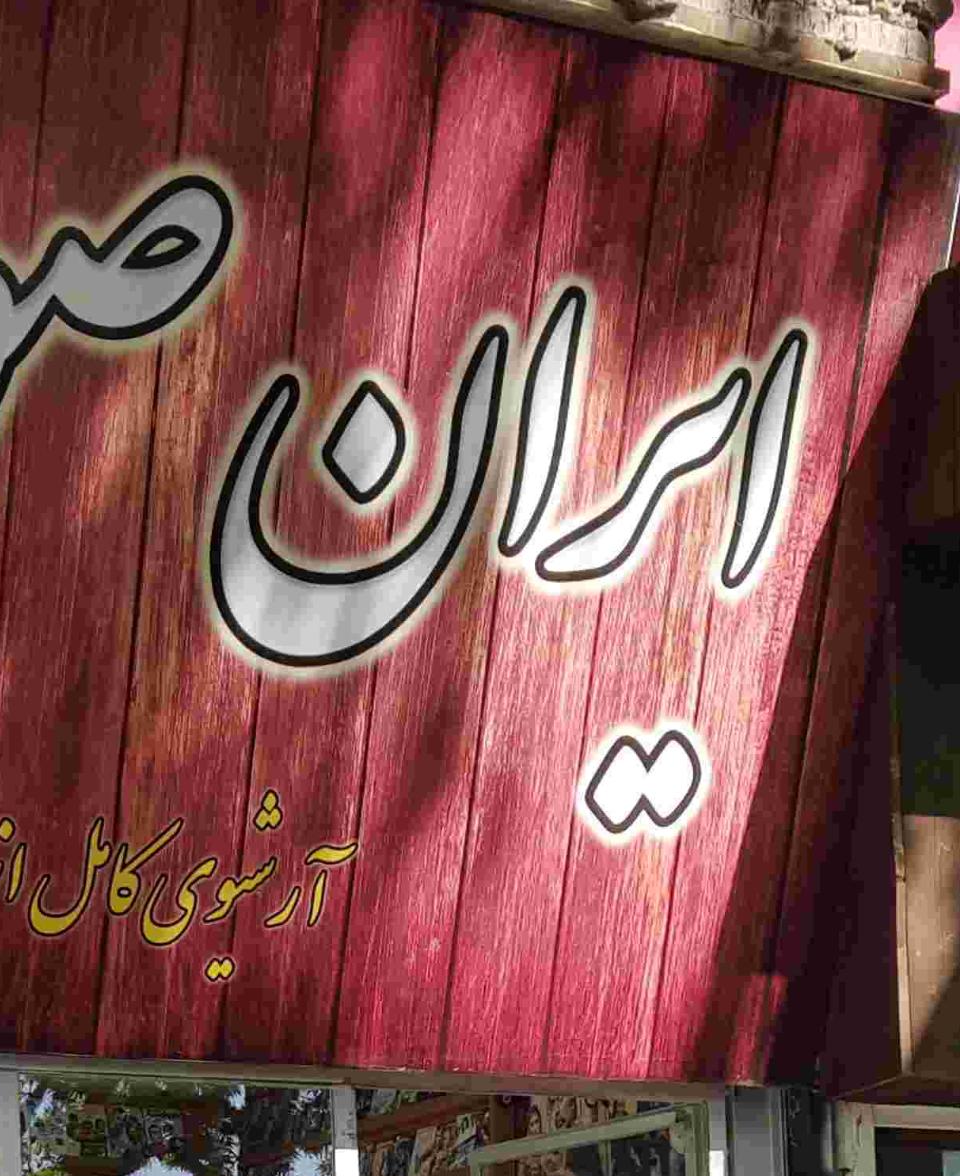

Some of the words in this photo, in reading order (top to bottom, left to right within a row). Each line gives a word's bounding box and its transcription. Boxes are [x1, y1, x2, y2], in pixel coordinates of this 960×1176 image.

[208, 280, 816, 840] ایران
[28, 816, 185, 938] کامل
[139, 788, 358, 982] آرشیوی
